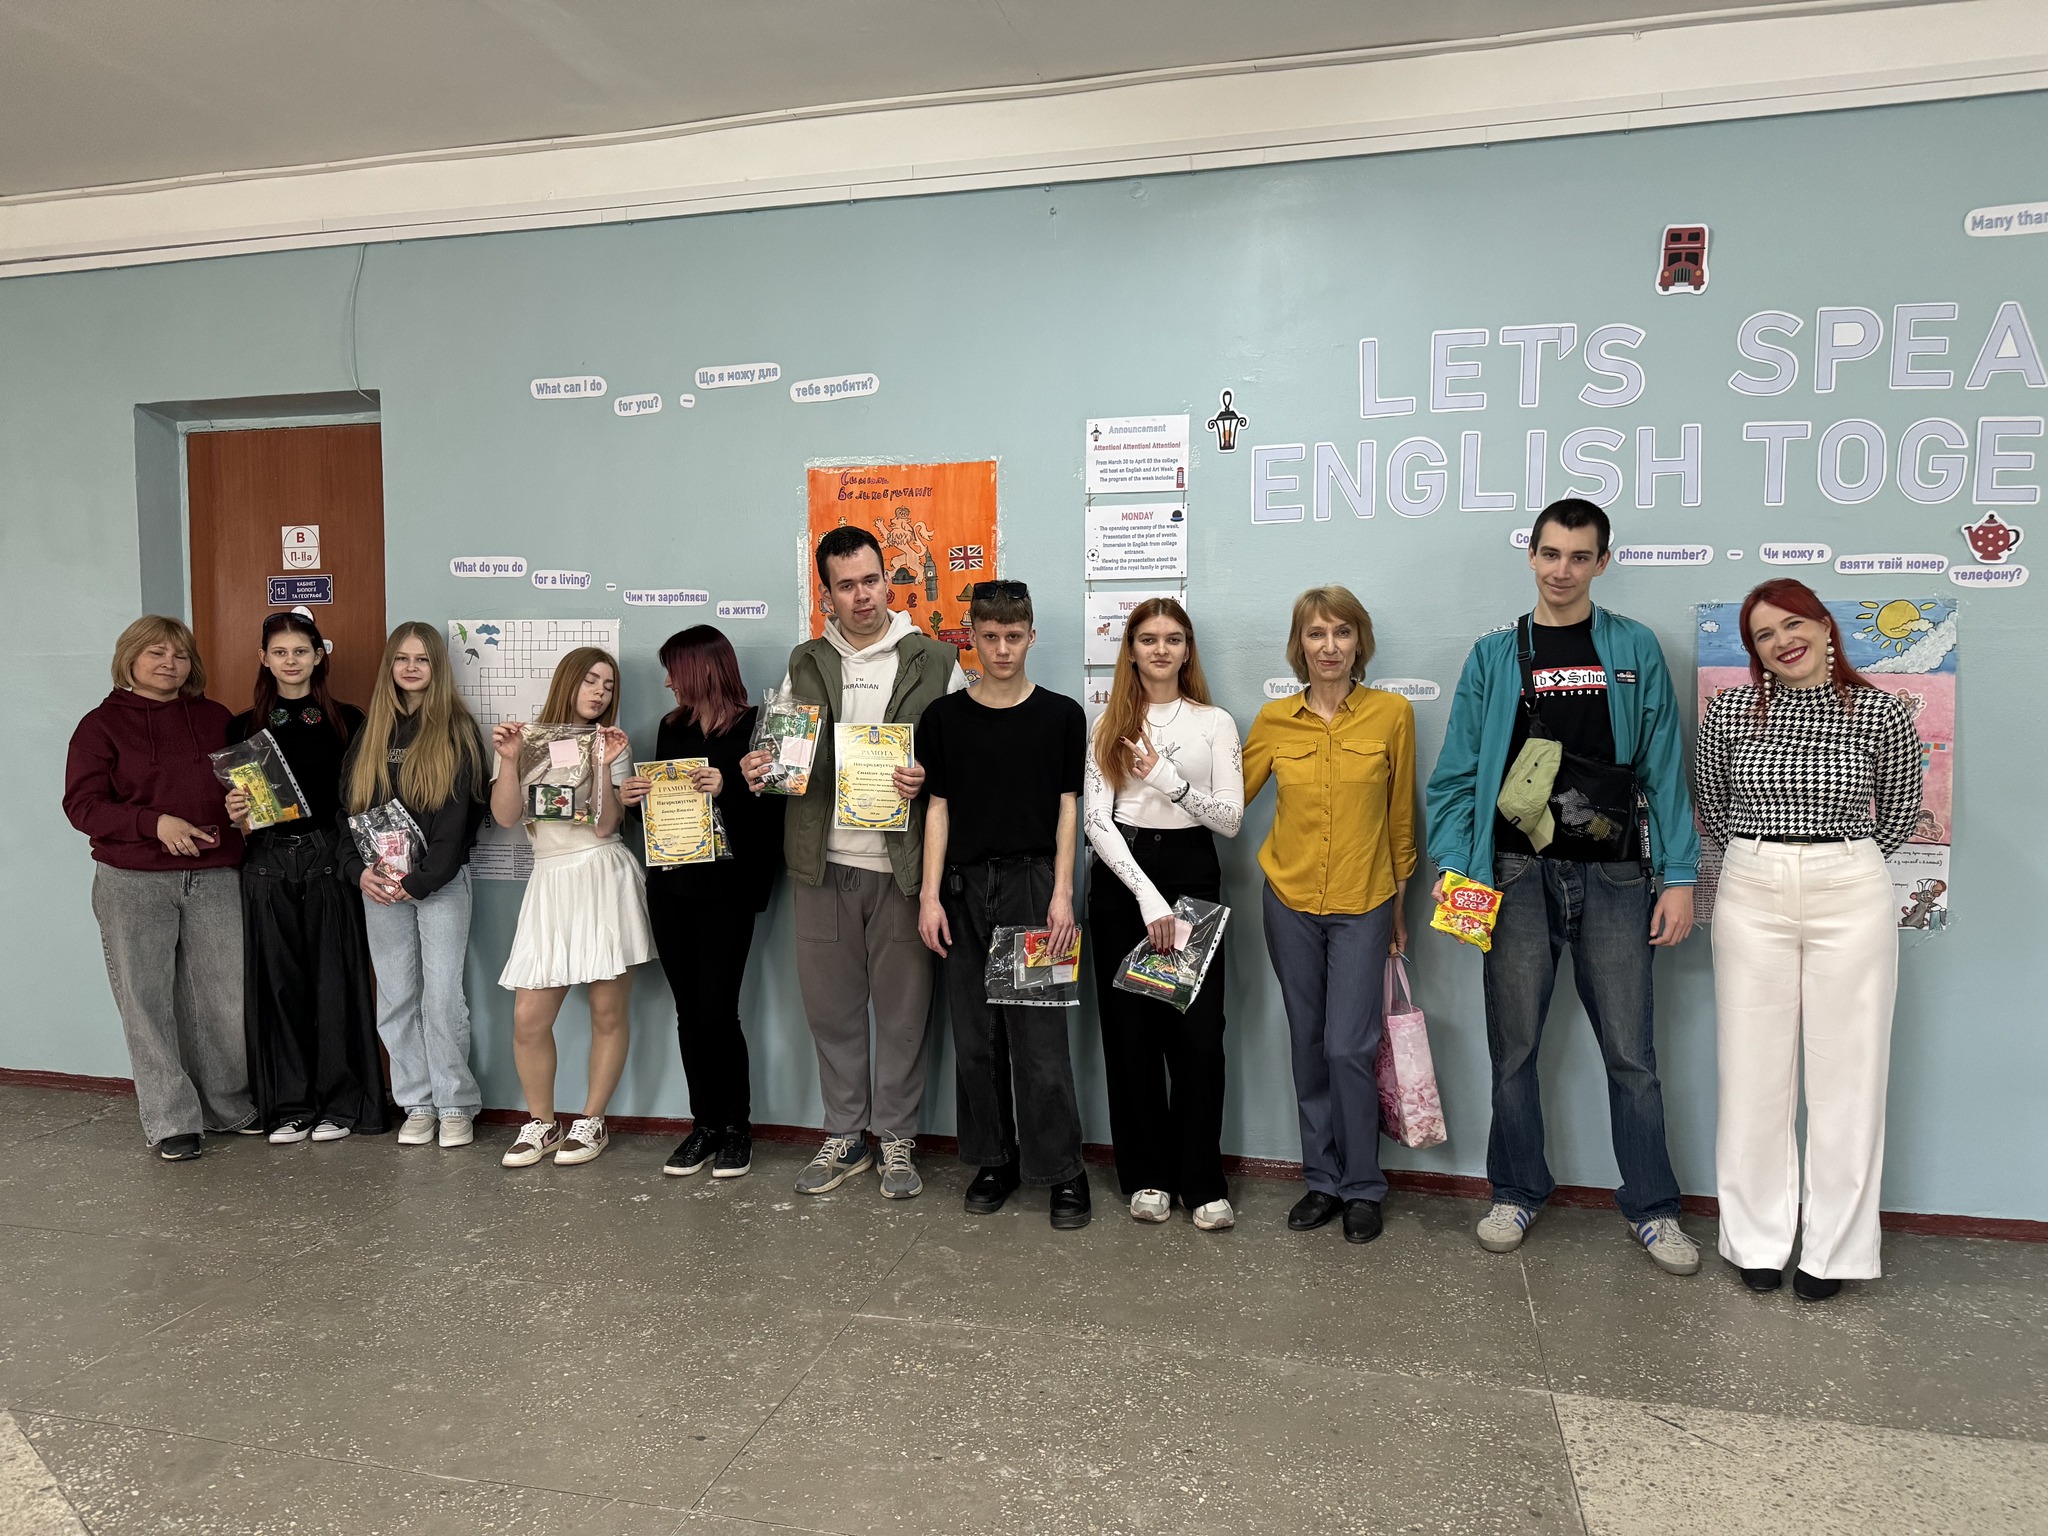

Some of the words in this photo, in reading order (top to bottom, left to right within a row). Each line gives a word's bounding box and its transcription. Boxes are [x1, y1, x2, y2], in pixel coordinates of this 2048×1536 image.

[1971, 215, 2014, 231] Many
[1728, 301, 2047, 396] SPEA
[699, 371, 715, 386] Що
[718, 372, 724, 382] я
[727, 369, 755, 383] можу
[758, 366, 778, 380] для
[535, 382, 561, 395] What
[563, 382, 582, 394] can
[583, 380, 587, 392] I
[590, 379, 602, 391] do
[795, 383, 821, 397] тебе
[824, 376, 874, 397] зробити?
[618, 400, 633, 412] for
[636, 396, 659, 413] you?
[1108, 424, 1166, 434] Announcement
[1251, 422, 1702, 524] ENGLISH
[1743, 415, 2045, 507] TOGE
[1121, 511, 1154, 521] MONDAY
[1618, 549, 1653, 562] phone
[1657, 549, 1708, 561] number?
[1763, 548, 1779, 559] Чи
[1782, 549, 1814, 562] можу
[1817, 549, 1824, 559] я
[454, 561, 476, 573] What
[479, 561, 490, 573] do
[492, 563, 509, 575] you
[511, 561, 523, 573] do
[1840, 559, 1874, 571] взяти
[1878, 557, 1902, 570] твій
[1906, 559, 1945, 572] номер
[534, 573, 548, 585] for
[551, 575, 557, 585] a
[559, 573, 591, 588] living?
[1954, 568, 2023, 583] телефону?
[277, 587, 285, 595] 13
[625, 591, 643, 602] Чим
[645, 593, 655, 602] ти
[658, 591, 708, 604] заробляєш
[719, 606, 730, 615] на
[732, 604, 766, 615] життя?
[1118, 602, 1138, 611] TUES
[1533, 675, 1547, 686] ld
[1269, 683, 1300, 694] You're
